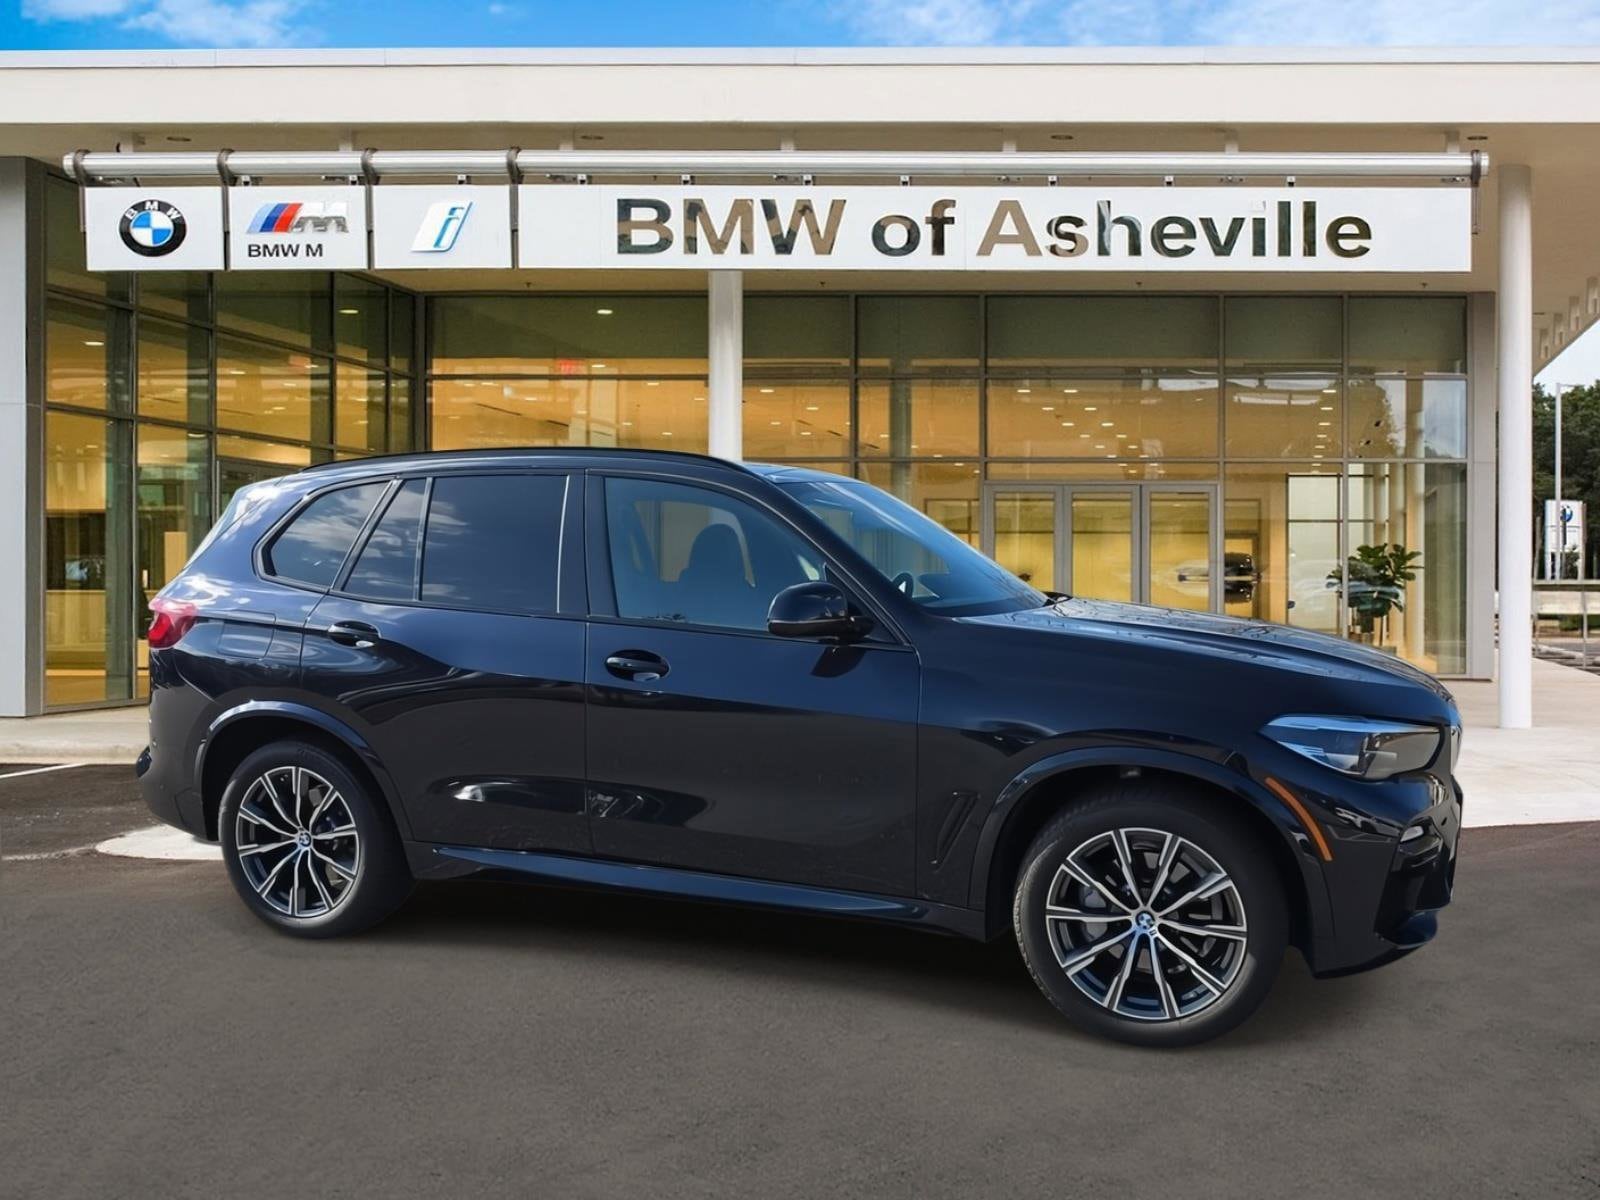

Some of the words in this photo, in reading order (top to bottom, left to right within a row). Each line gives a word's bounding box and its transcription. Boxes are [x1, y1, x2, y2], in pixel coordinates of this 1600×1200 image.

[124, 200, 181, 220] BMW
[616, 198, 847, 255] BMW
[871, 199, 957, 257] of
[976, 199, 1372, 258] Asheville
[247, 243, 300, 258] BMW
[305, 243, 323, 258] M
